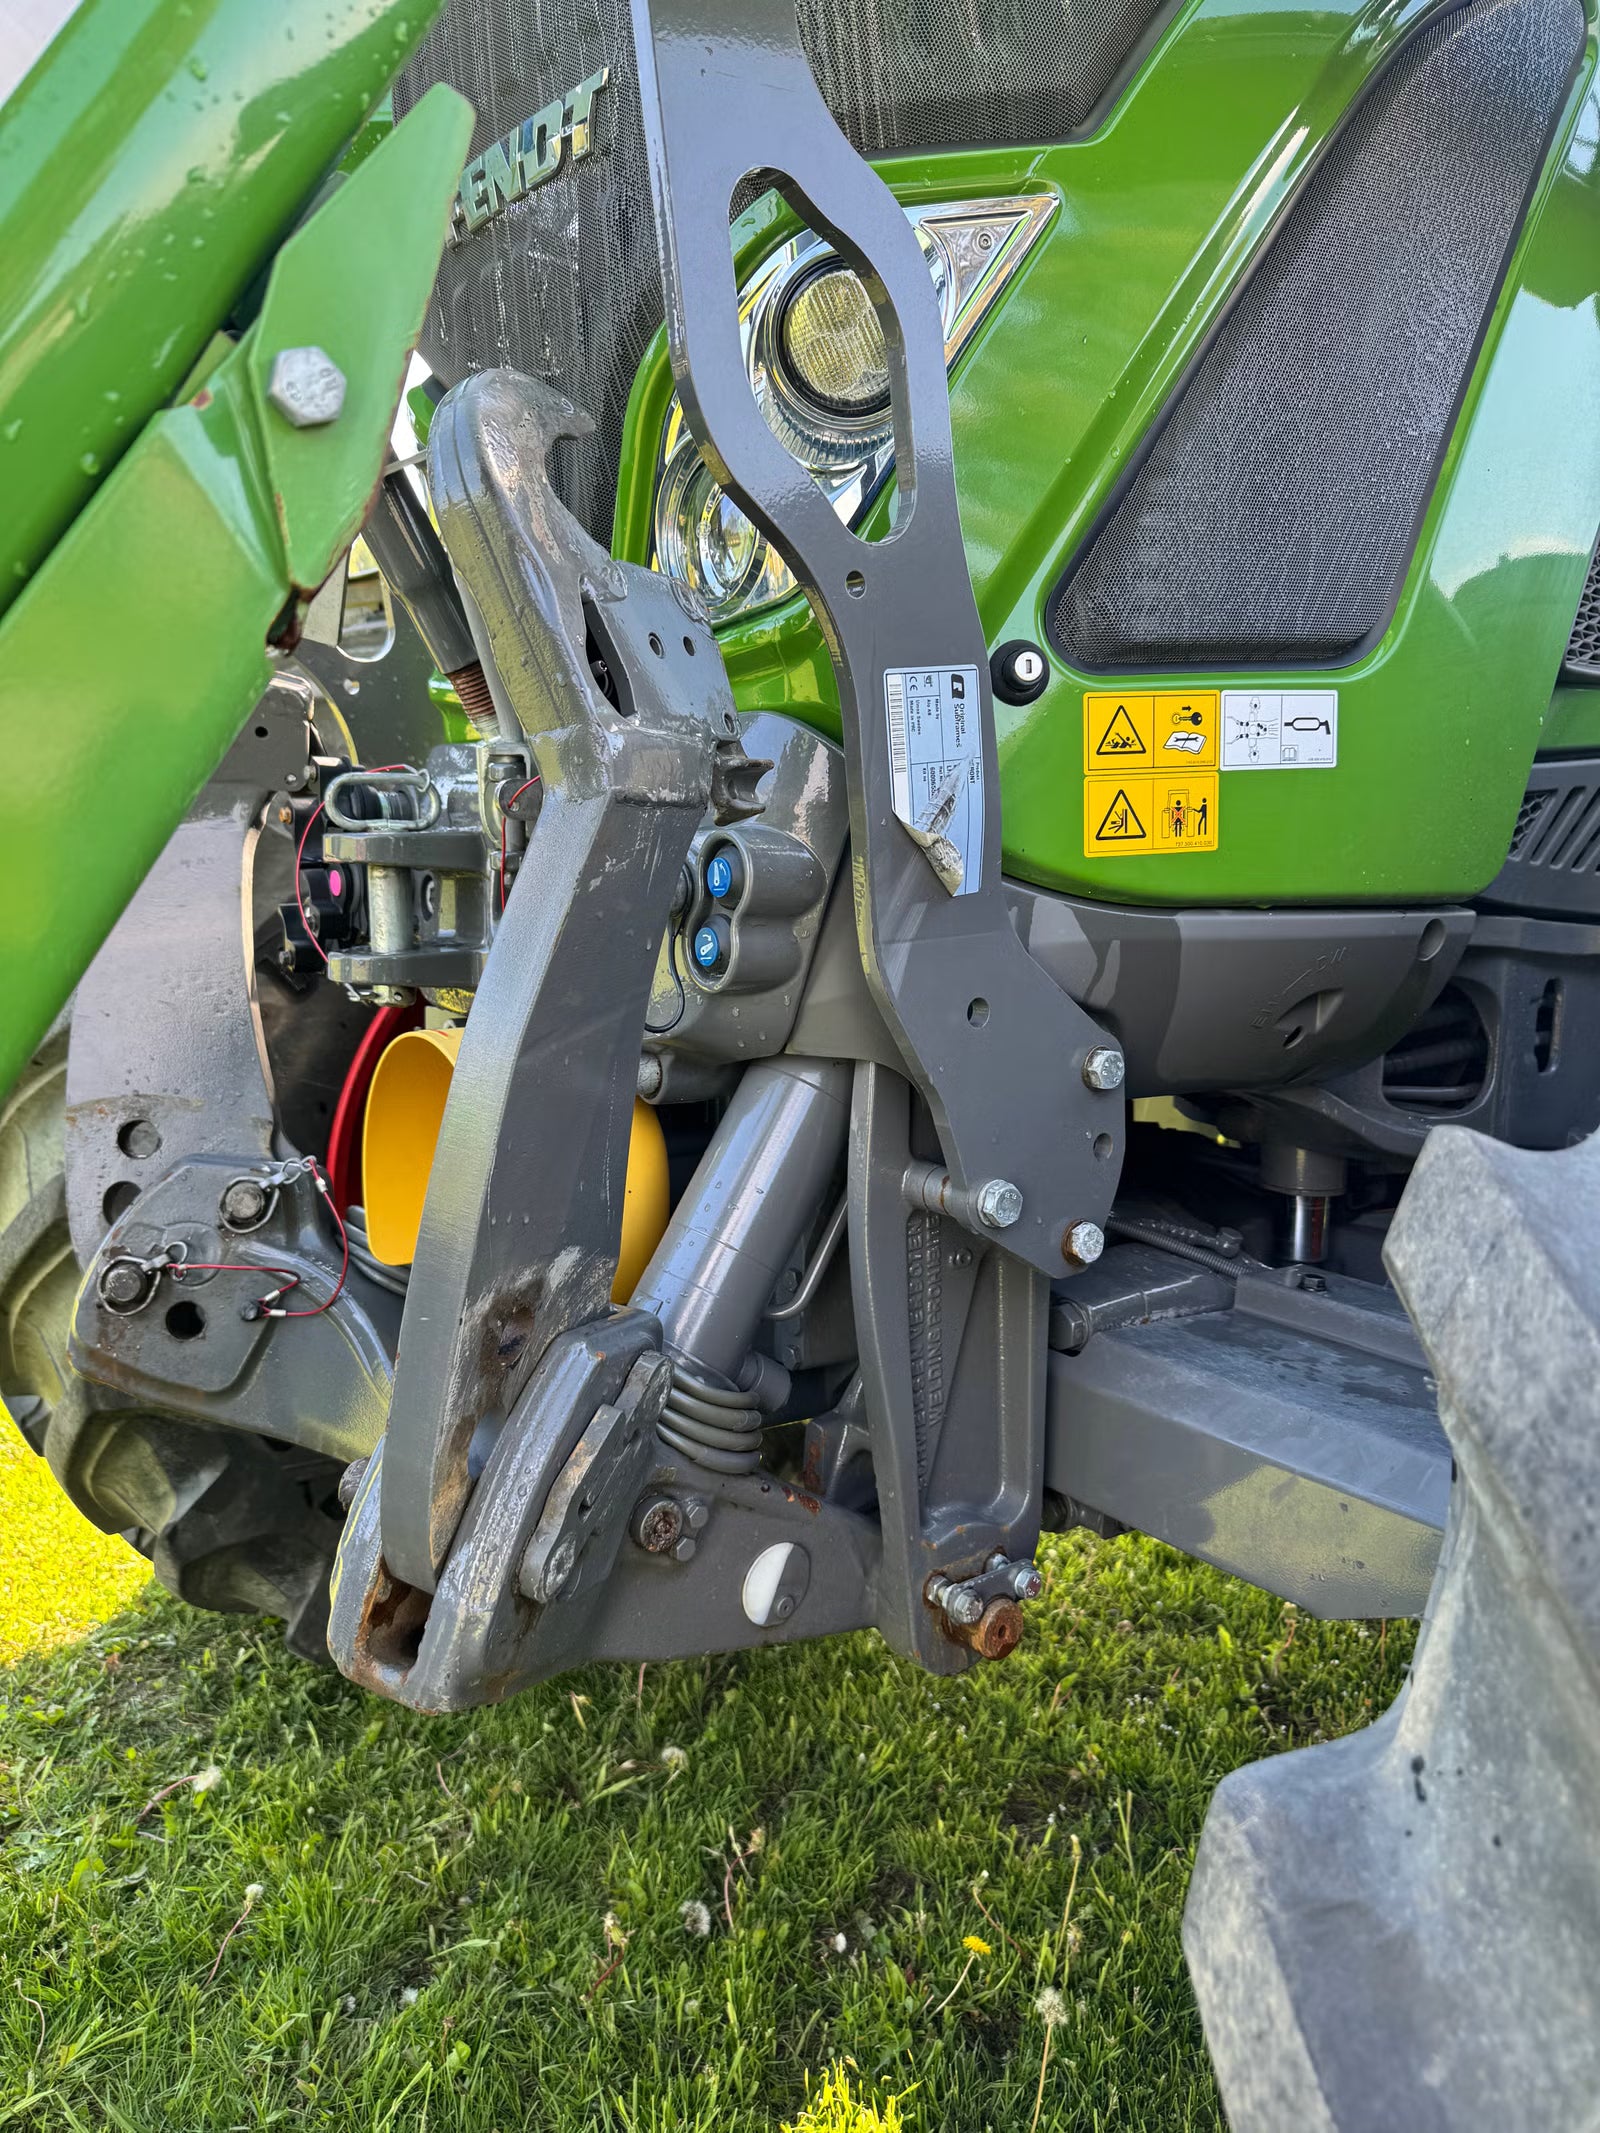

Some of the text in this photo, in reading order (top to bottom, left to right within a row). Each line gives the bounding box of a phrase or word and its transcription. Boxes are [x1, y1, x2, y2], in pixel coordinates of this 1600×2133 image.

[957, 703, 966, 734] Original
[907, 1220, 924, 1340] VERBOTEN
[927, 1326, 944, 1426] WELDING
